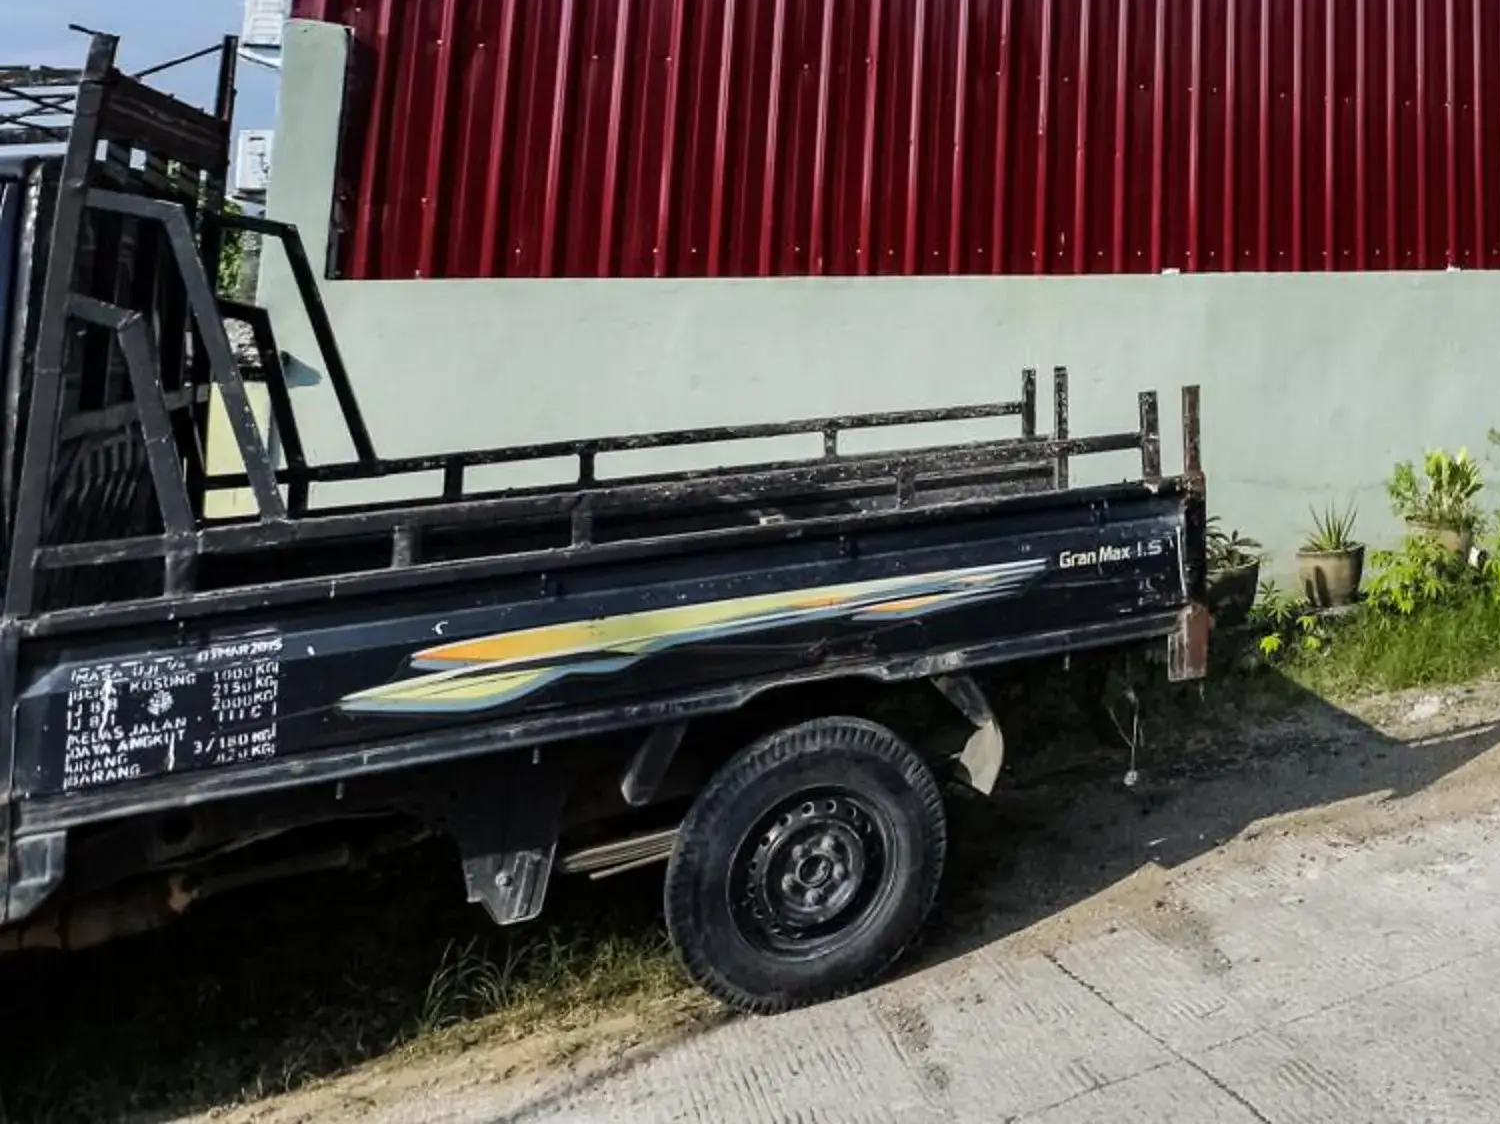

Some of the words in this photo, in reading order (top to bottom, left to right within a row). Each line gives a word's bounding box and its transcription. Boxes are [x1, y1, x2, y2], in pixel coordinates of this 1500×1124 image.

[1060, 550, 1097, 568] Gran
[1099, 545, 1131, 562] Max
[129, 716, 187, 737] JALAN
